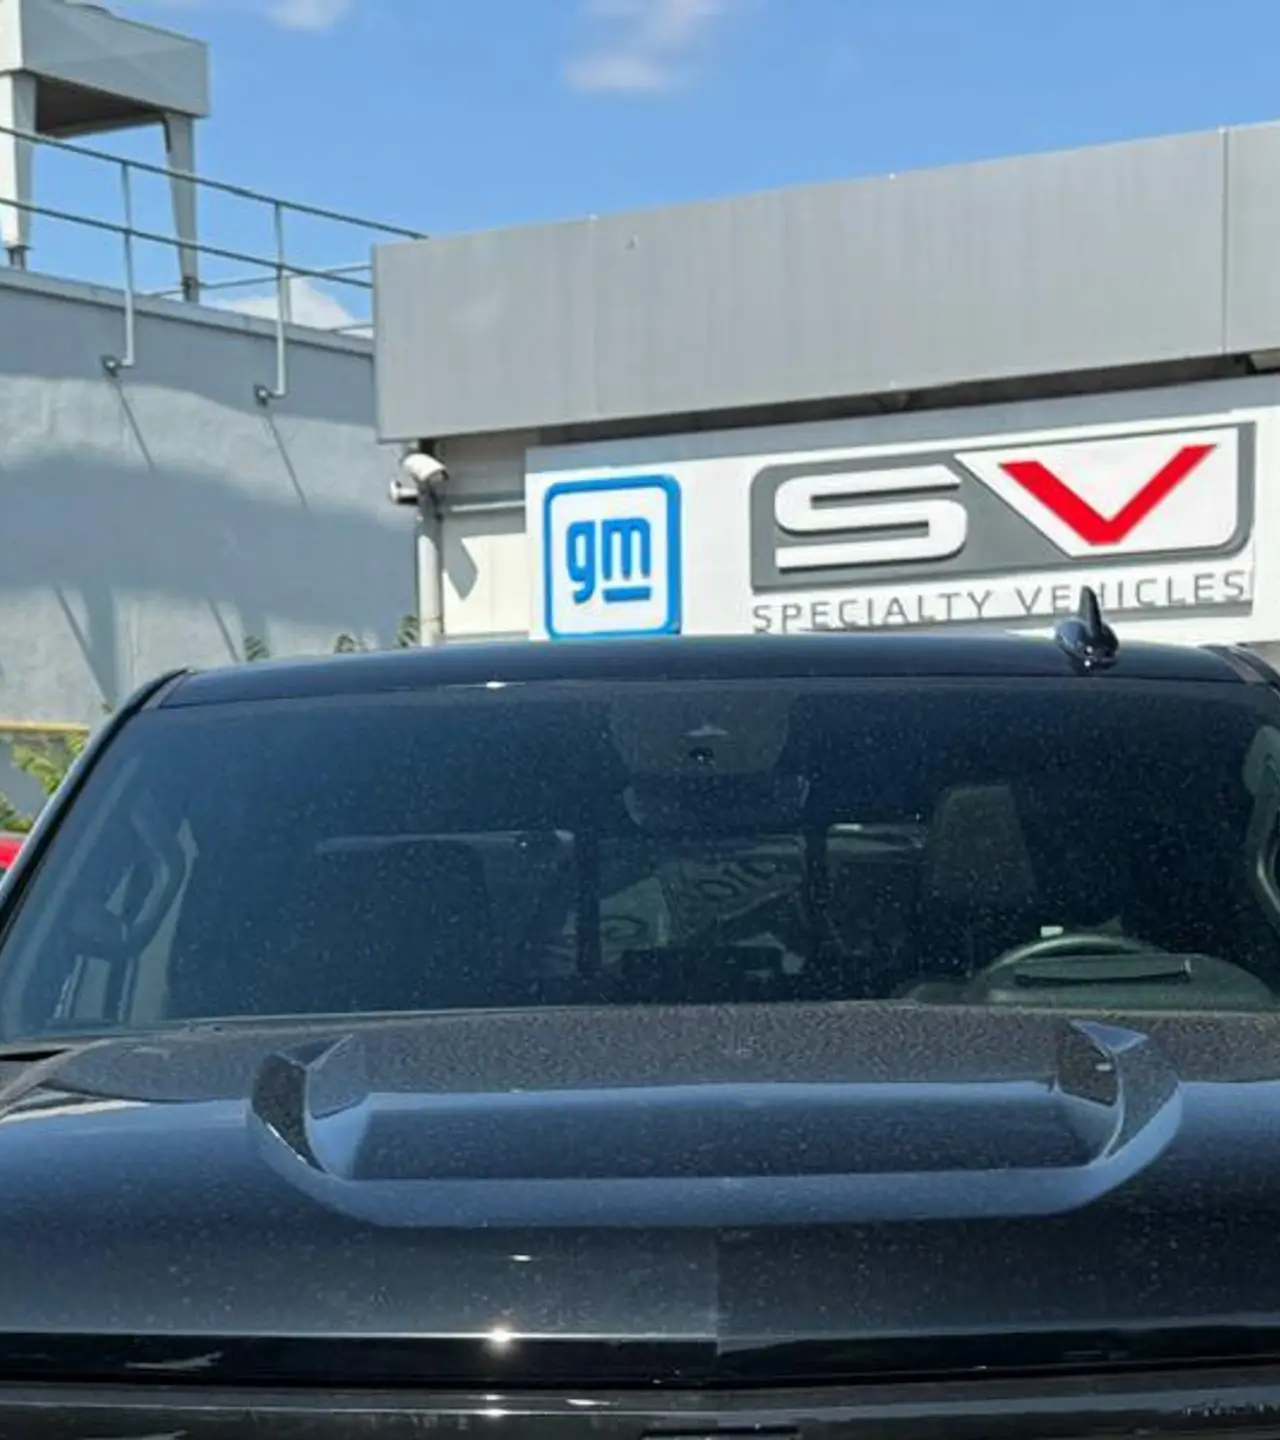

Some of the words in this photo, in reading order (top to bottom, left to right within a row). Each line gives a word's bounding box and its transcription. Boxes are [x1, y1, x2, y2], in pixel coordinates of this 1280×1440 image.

[773, 443, 1220, 573] SV
[567, 513, 653, 604] gm
[752, 588, 993, 634] SPECIALTY
